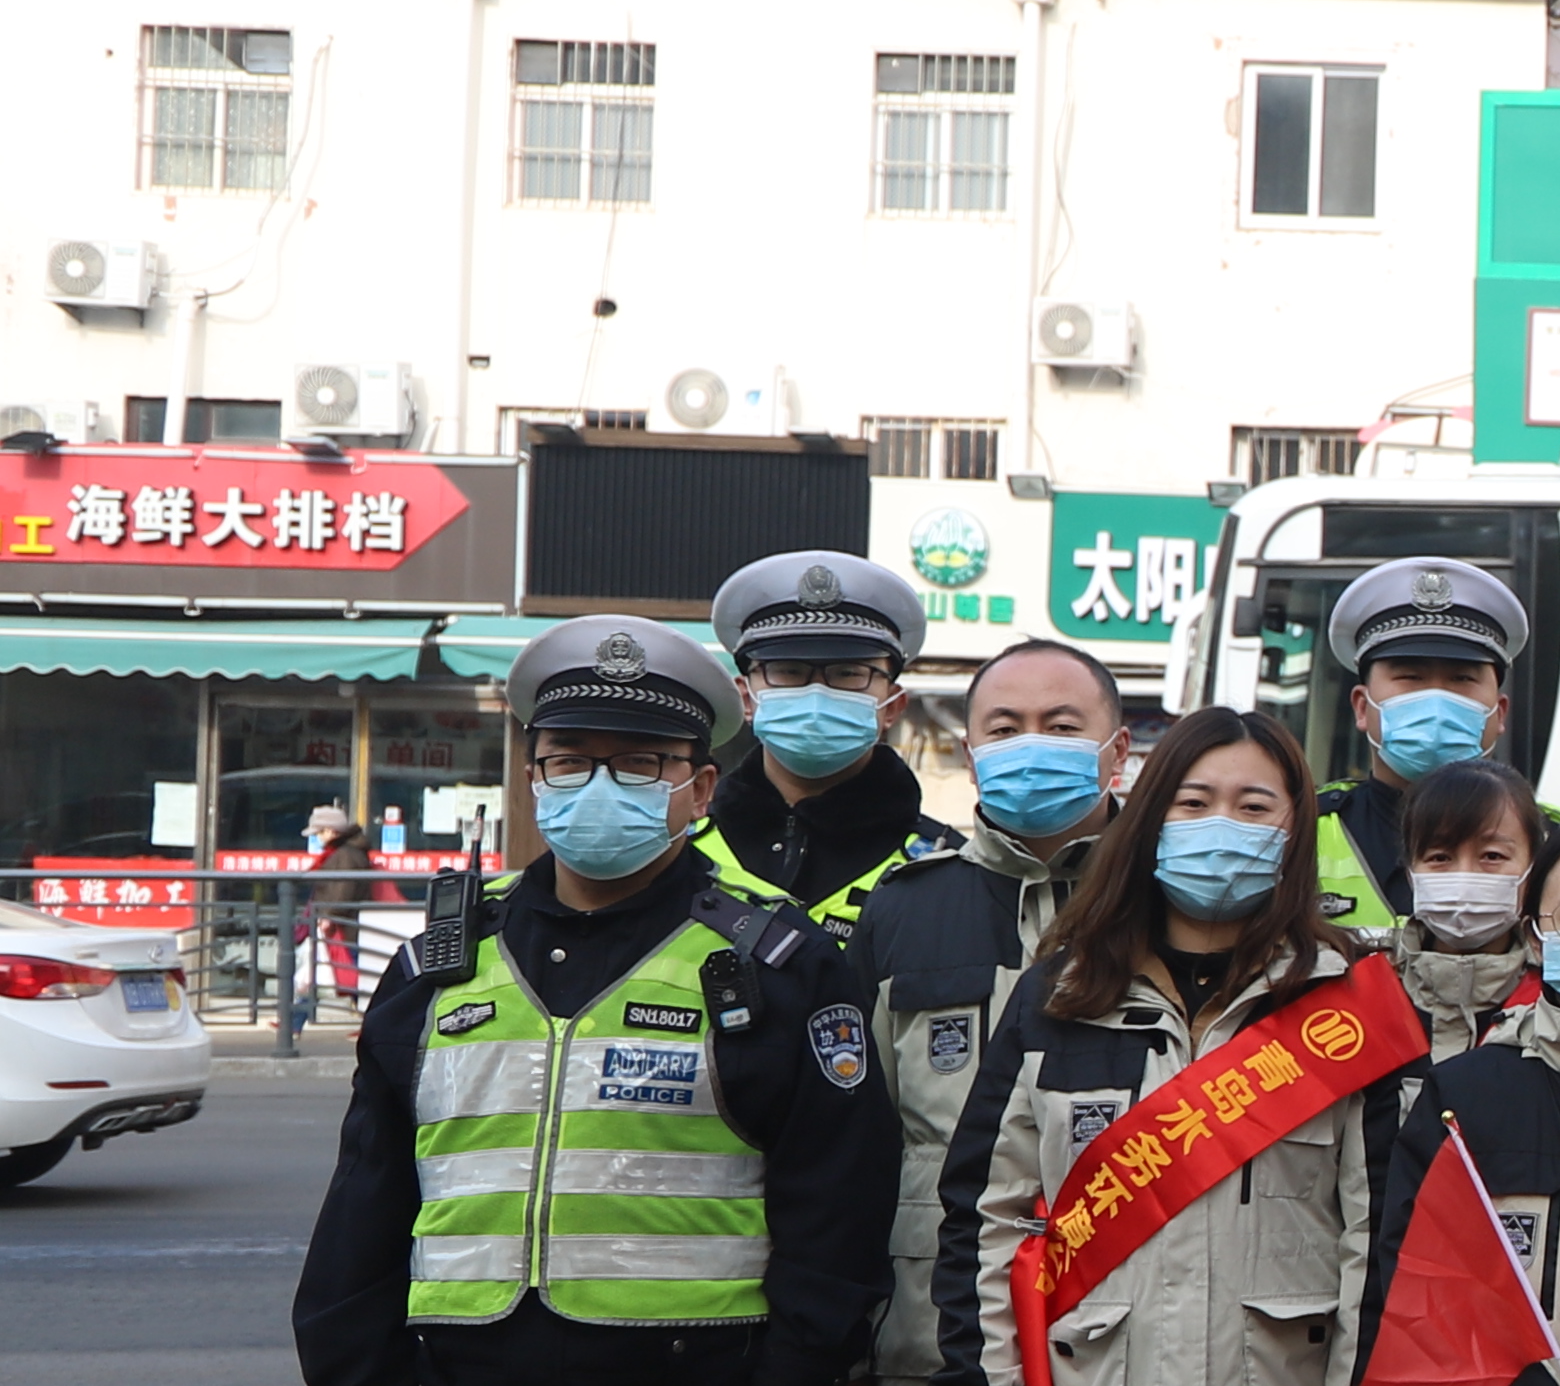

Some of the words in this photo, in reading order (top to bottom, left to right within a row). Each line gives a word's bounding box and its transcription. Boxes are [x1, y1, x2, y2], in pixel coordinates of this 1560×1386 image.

[66, 483, 408, 553] 海鲜大排档
[1072, 532, 1219, 623] 太阳
[628, 1006, 697, 1029] SN18017
[607, 1052, 694, 1079] AUXILIARY
[605, 1085, 688, 1104] POLICE
